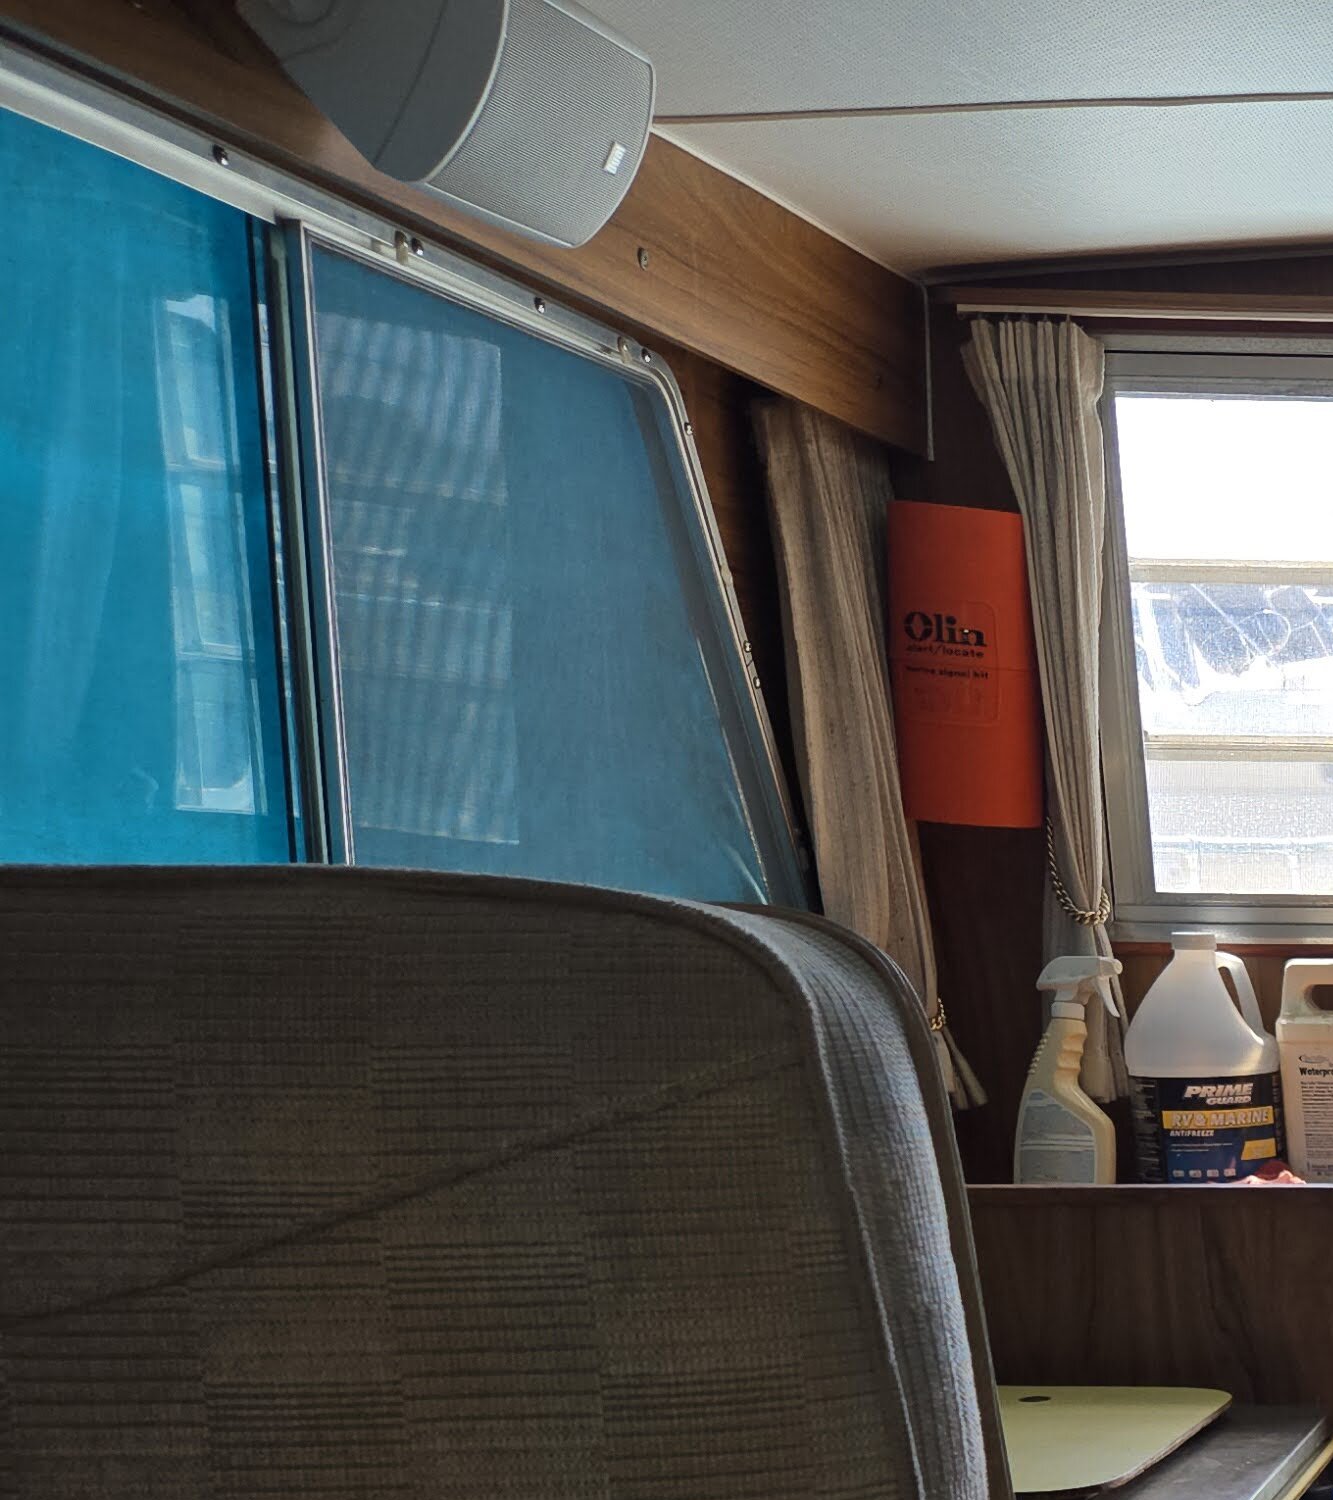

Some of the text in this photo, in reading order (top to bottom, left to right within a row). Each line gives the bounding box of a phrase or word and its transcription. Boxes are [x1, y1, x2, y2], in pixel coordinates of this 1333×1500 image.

[904, 611, 987, 647] Olin
[906, 644, 984, 658] alert/locate
[1184, 1083, 1254, 1098] PRIME
[1205, 1095, 1252, 1105] GUARD
[1210, 1109, 1269, 1127] MARINE
